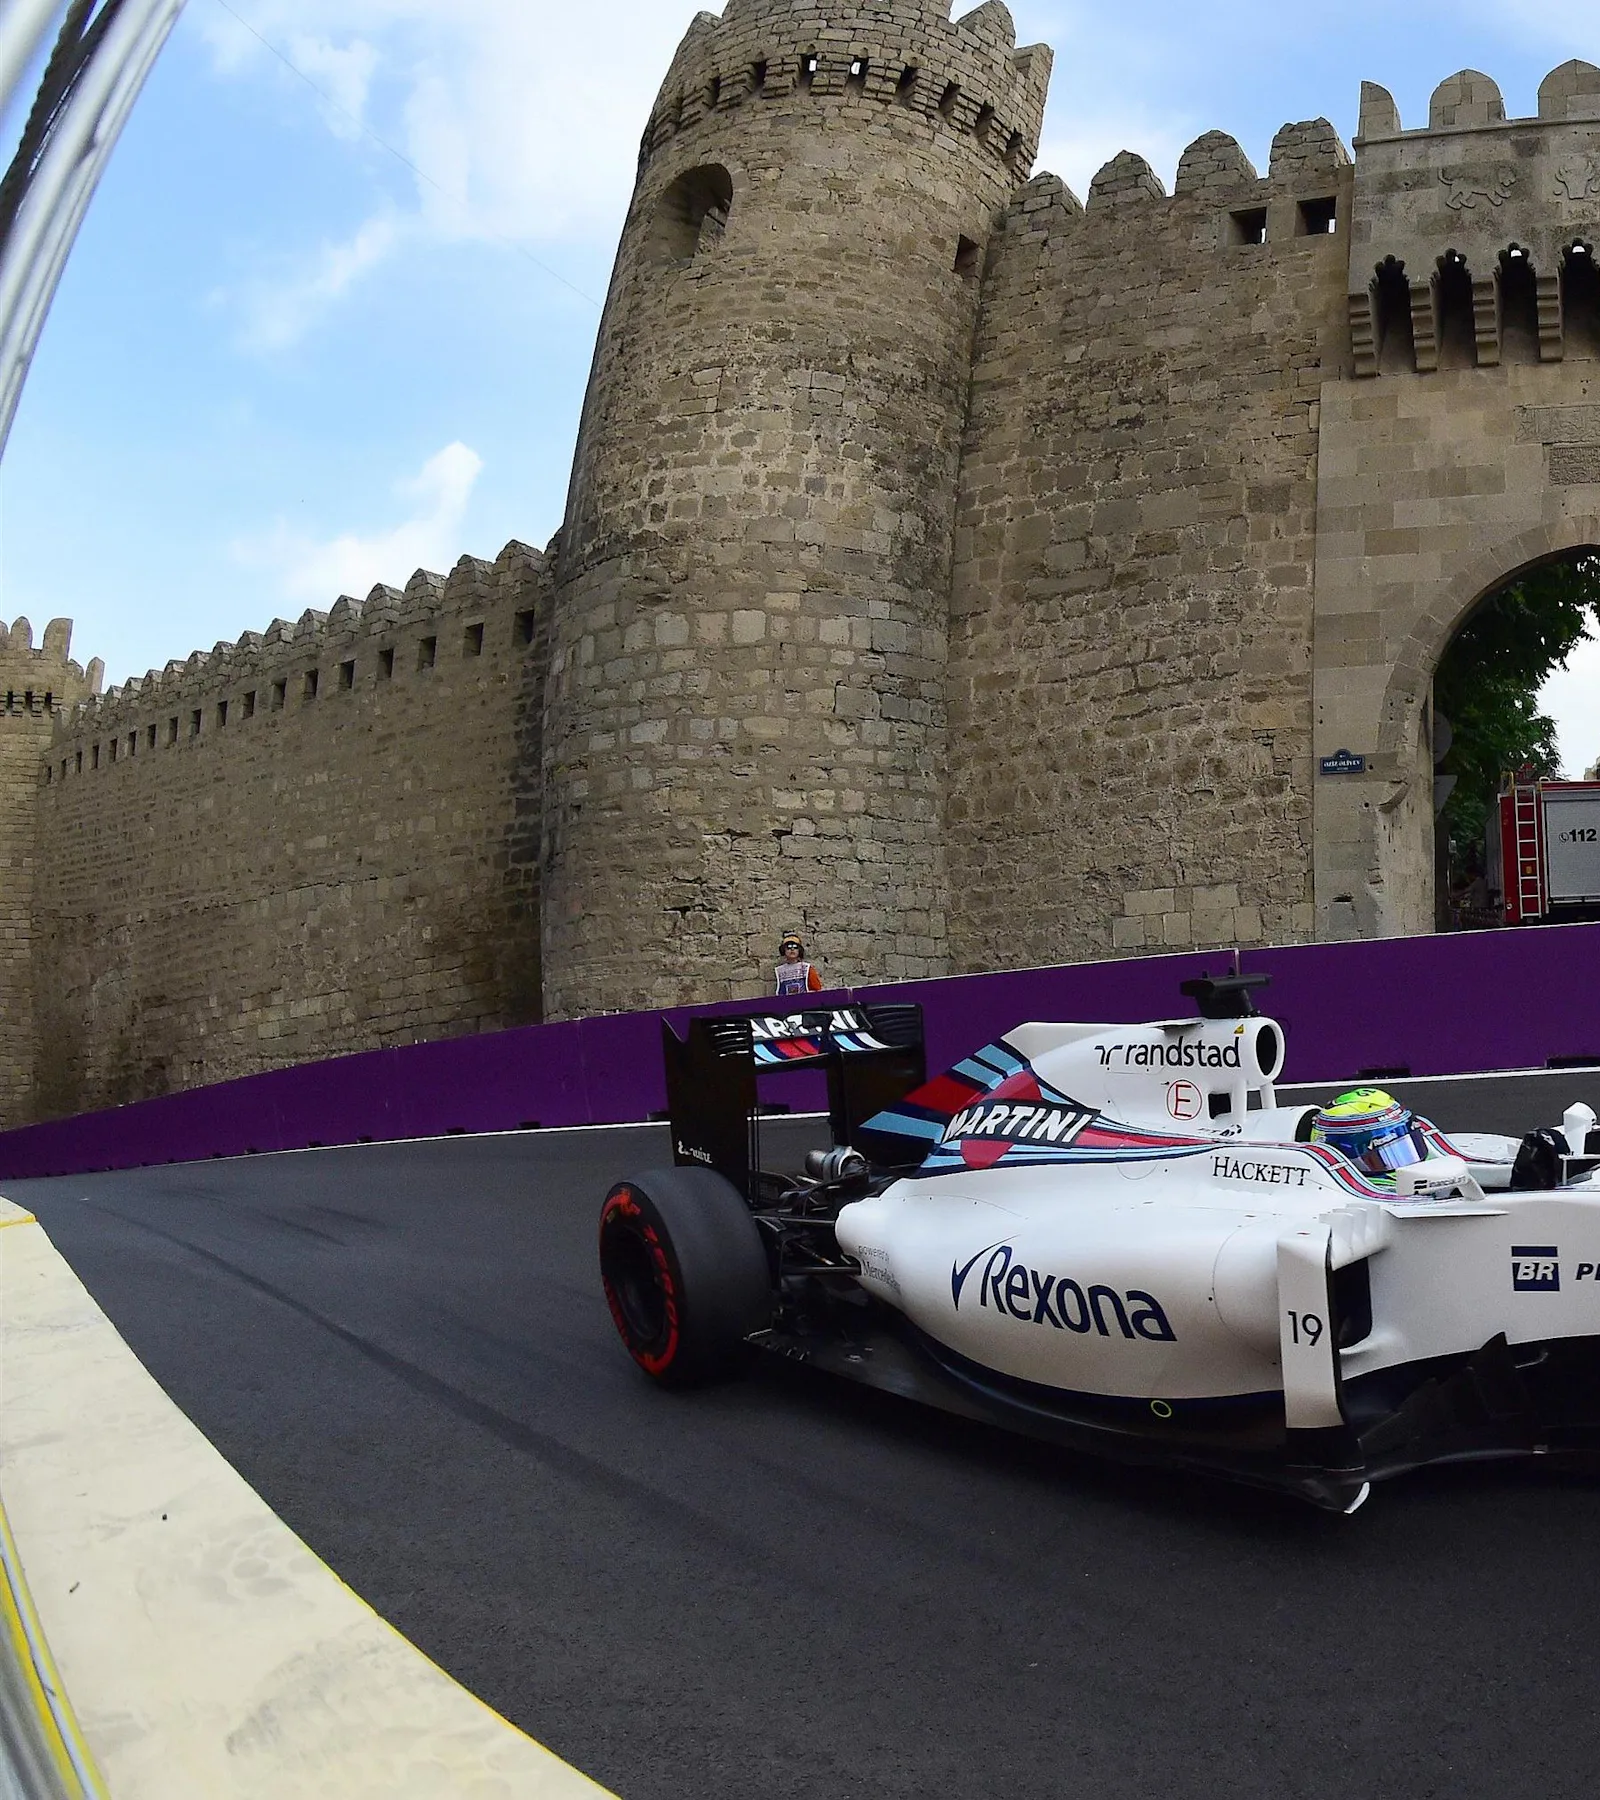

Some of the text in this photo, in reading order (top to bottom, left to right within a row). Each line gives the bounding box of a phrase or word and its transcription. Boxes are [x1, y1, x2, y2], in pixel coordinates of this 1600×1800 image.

[1569, 828, 1597, 842] 112
[1125, 1036, 1241, 1067] randstad
[1174, 1084, 1192, 1117] E
[943, 1106, 1092, 1143] MARTINI
[1212, 1156, 1311, 1186] HACKETT
[1516, 1262, 1555, 1281] BR
[980, 1245, 1178, 1342] Rexona
[1287, 1310, 1323, 1347] 19
